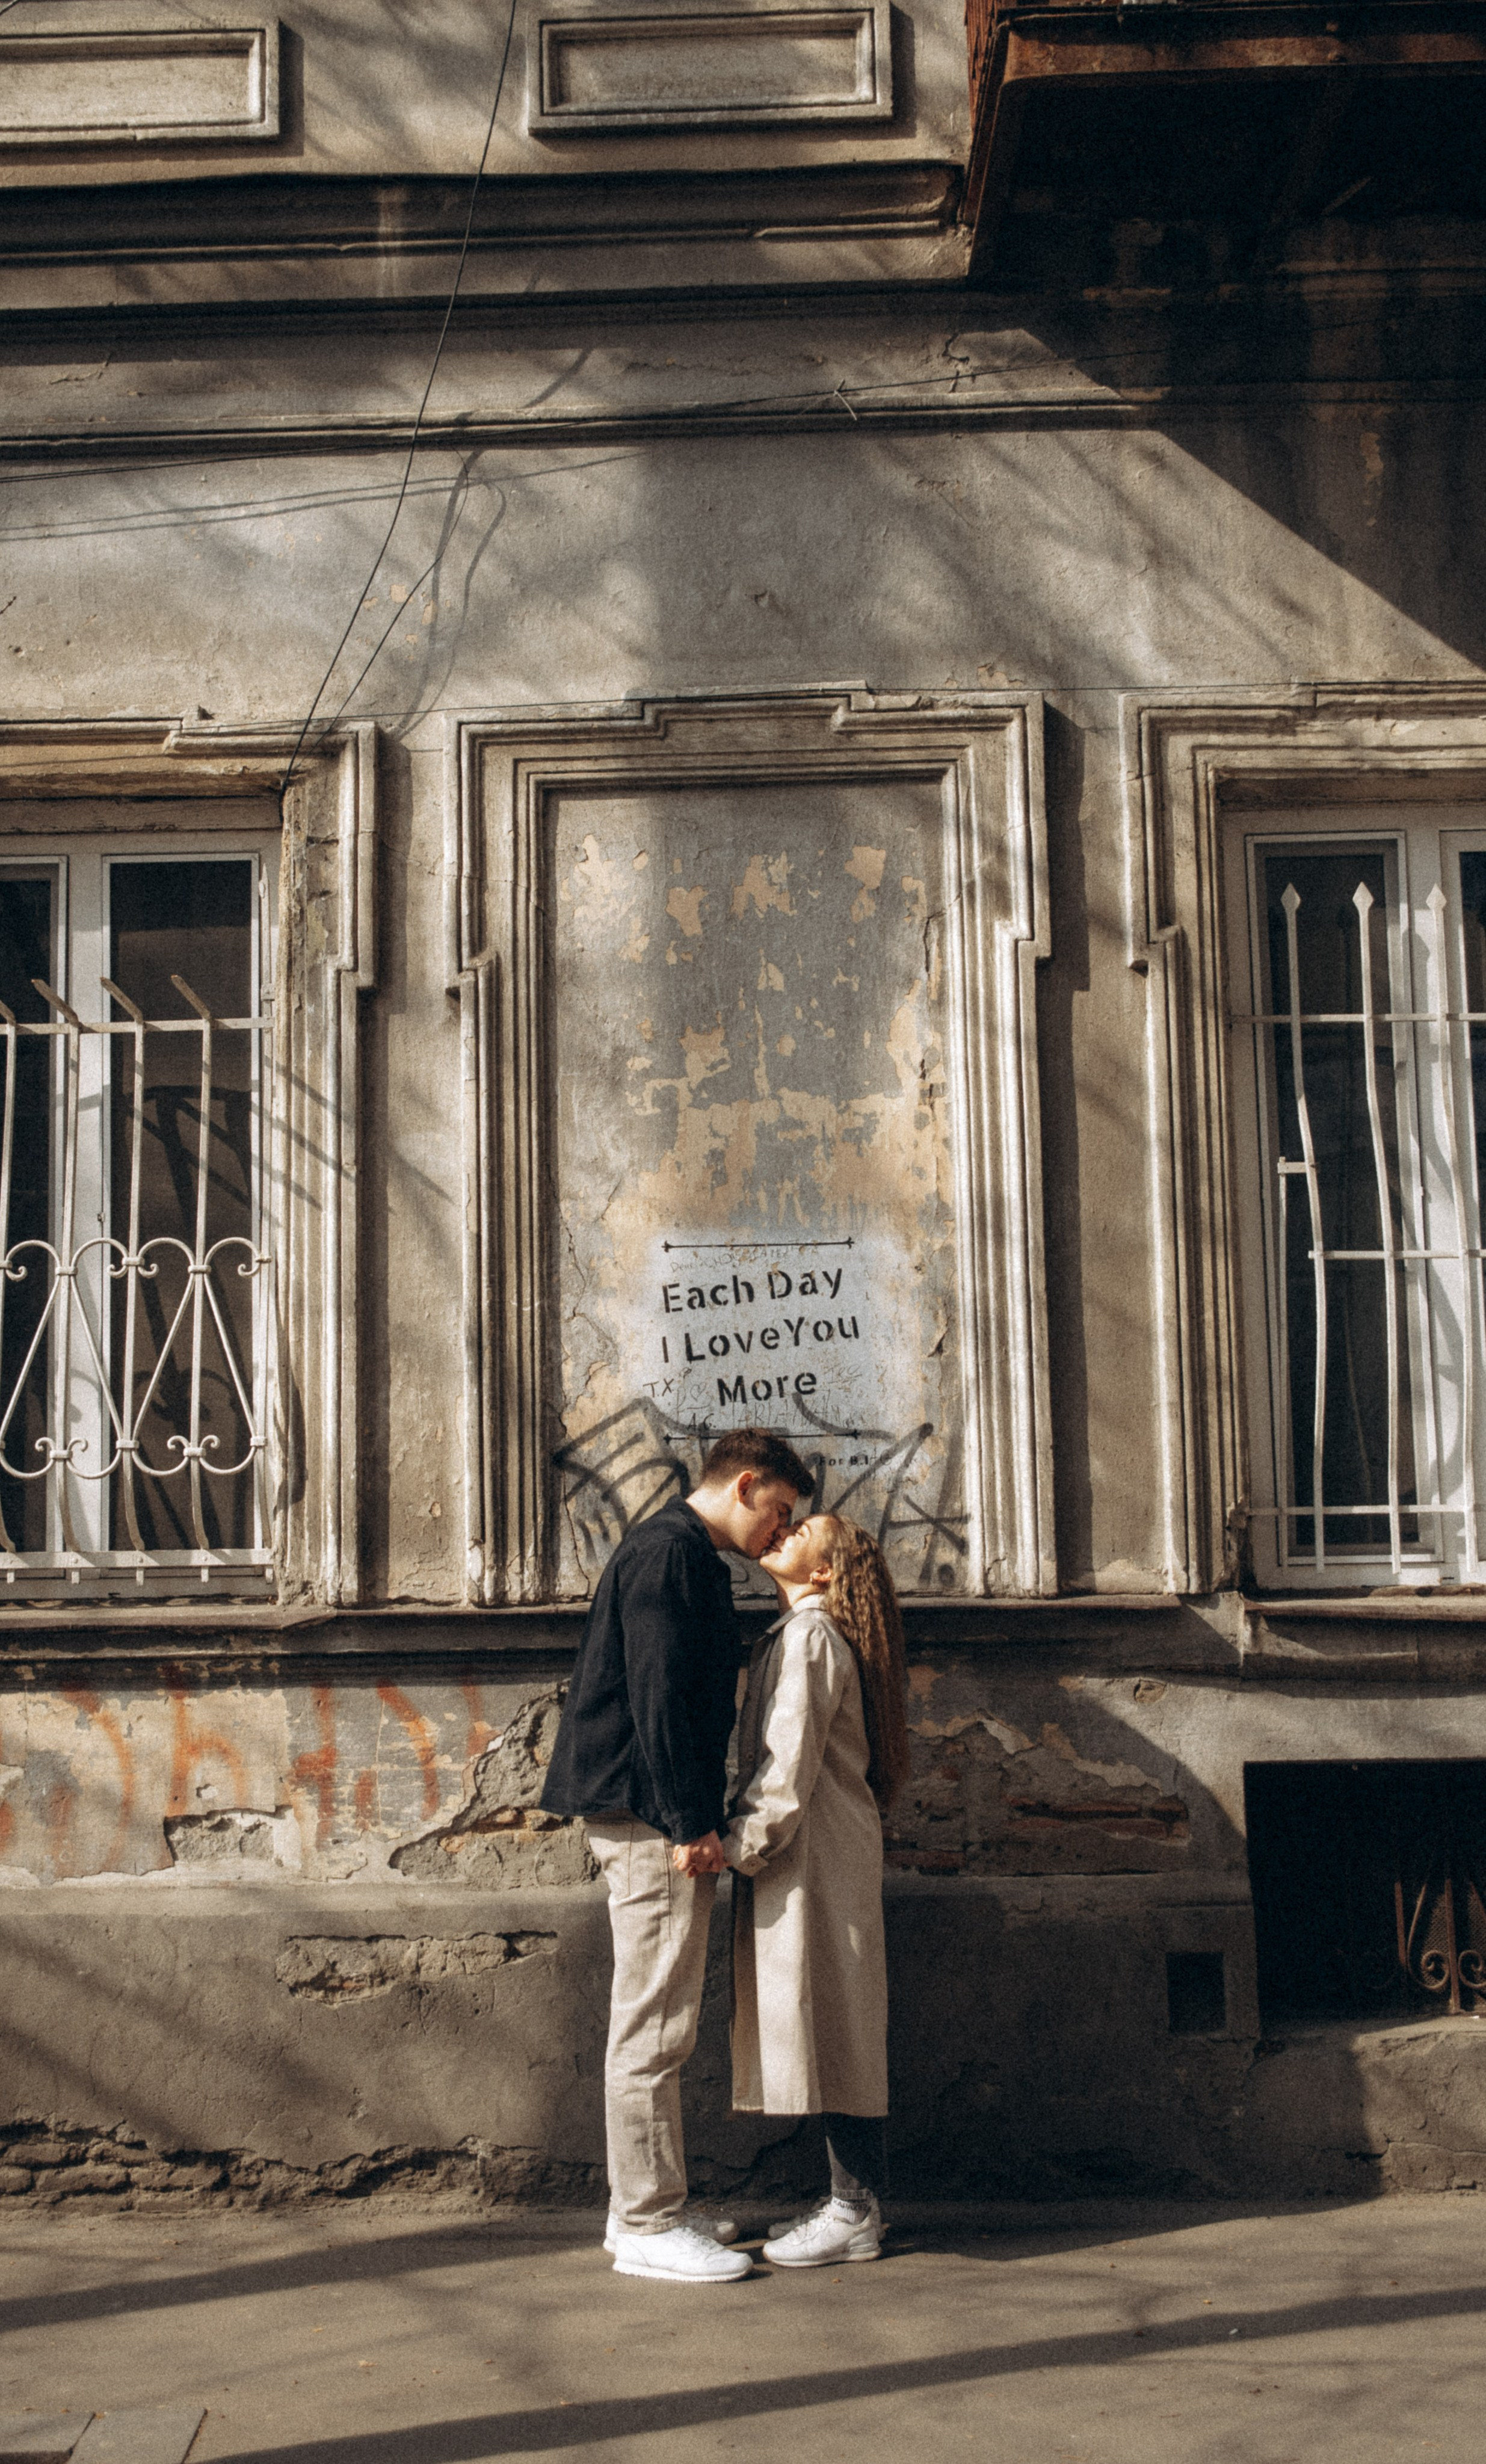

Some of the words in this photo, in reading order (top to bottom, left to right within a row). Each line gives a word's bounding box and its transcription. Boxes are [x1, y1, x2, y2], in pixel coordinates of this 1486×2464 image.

[662, 1275, 755, 1314] Each
[766, 1268, 843, 1299] Day
[662, 1336, 669, 1363] I
[717, 1372, 818, 1406] More
